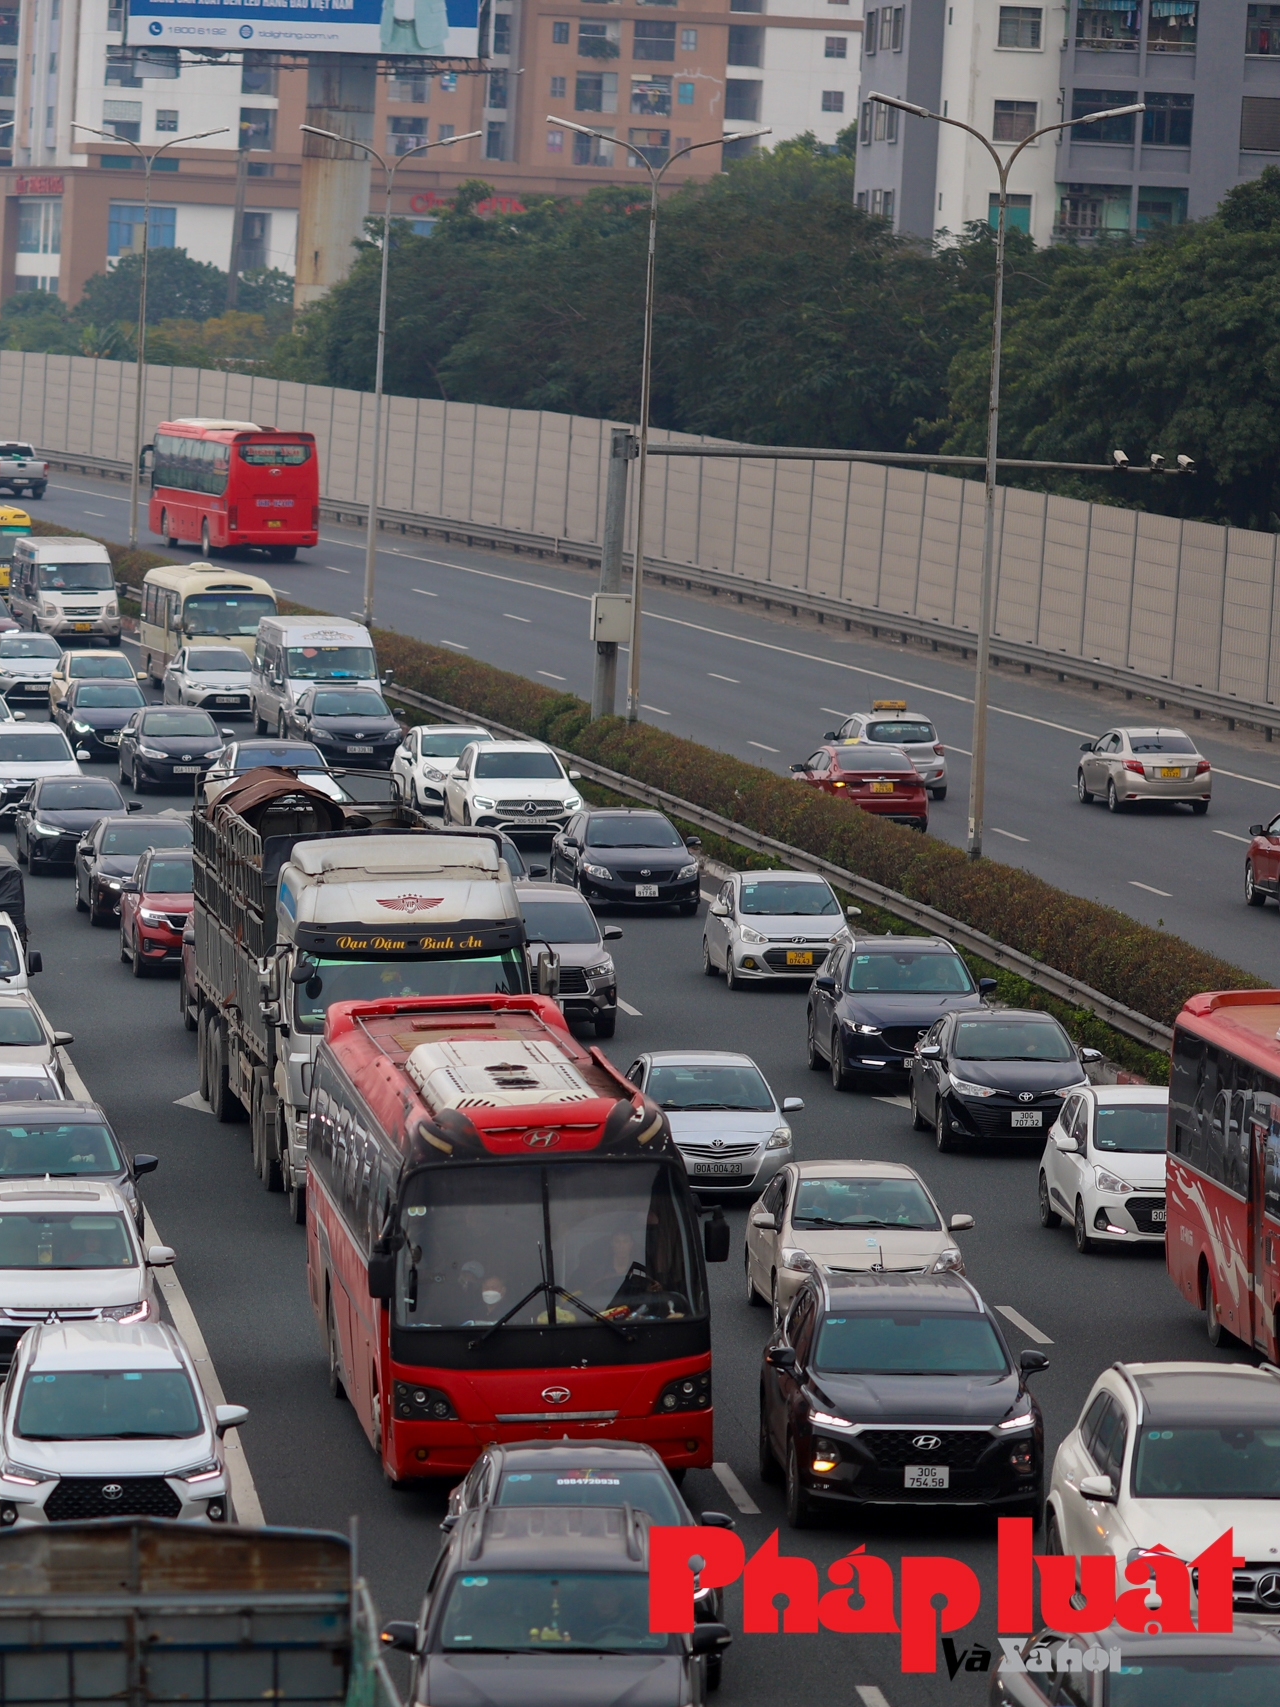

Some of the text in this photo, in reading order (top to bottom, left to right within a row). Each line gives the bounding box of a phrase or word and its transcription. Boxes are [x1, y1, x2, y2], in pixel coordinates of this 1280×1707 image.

[167, 26, 196, 35] 1800
[371, 937, 406, 951] Dặm
[420, 936, 455, 949] Bình
[459, 935, 483, 948] An
[917, 1467, 937, 1477] 30G
[909, 1478, 945, 1487] 754.58
